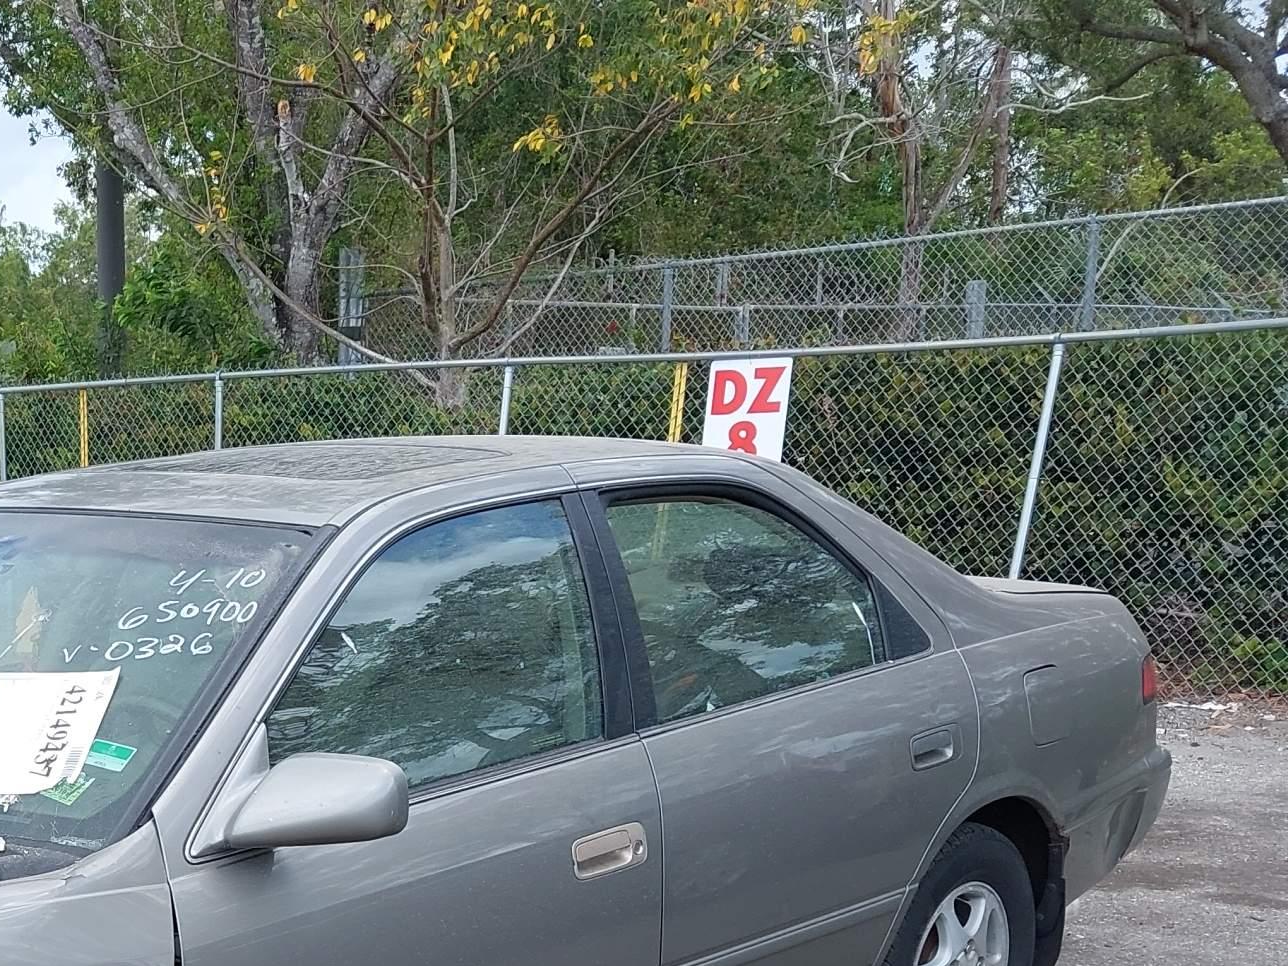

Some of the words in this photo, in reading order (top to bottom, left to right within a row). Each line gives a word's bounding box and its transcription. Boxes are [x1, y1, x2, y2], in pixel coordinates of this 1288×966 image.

[711, 366, 787, 415] DZ
[728, 420, 757, 455] 8
[169, 567, 266, 595] 4-10
[118, 598, 258, 630] 650900
